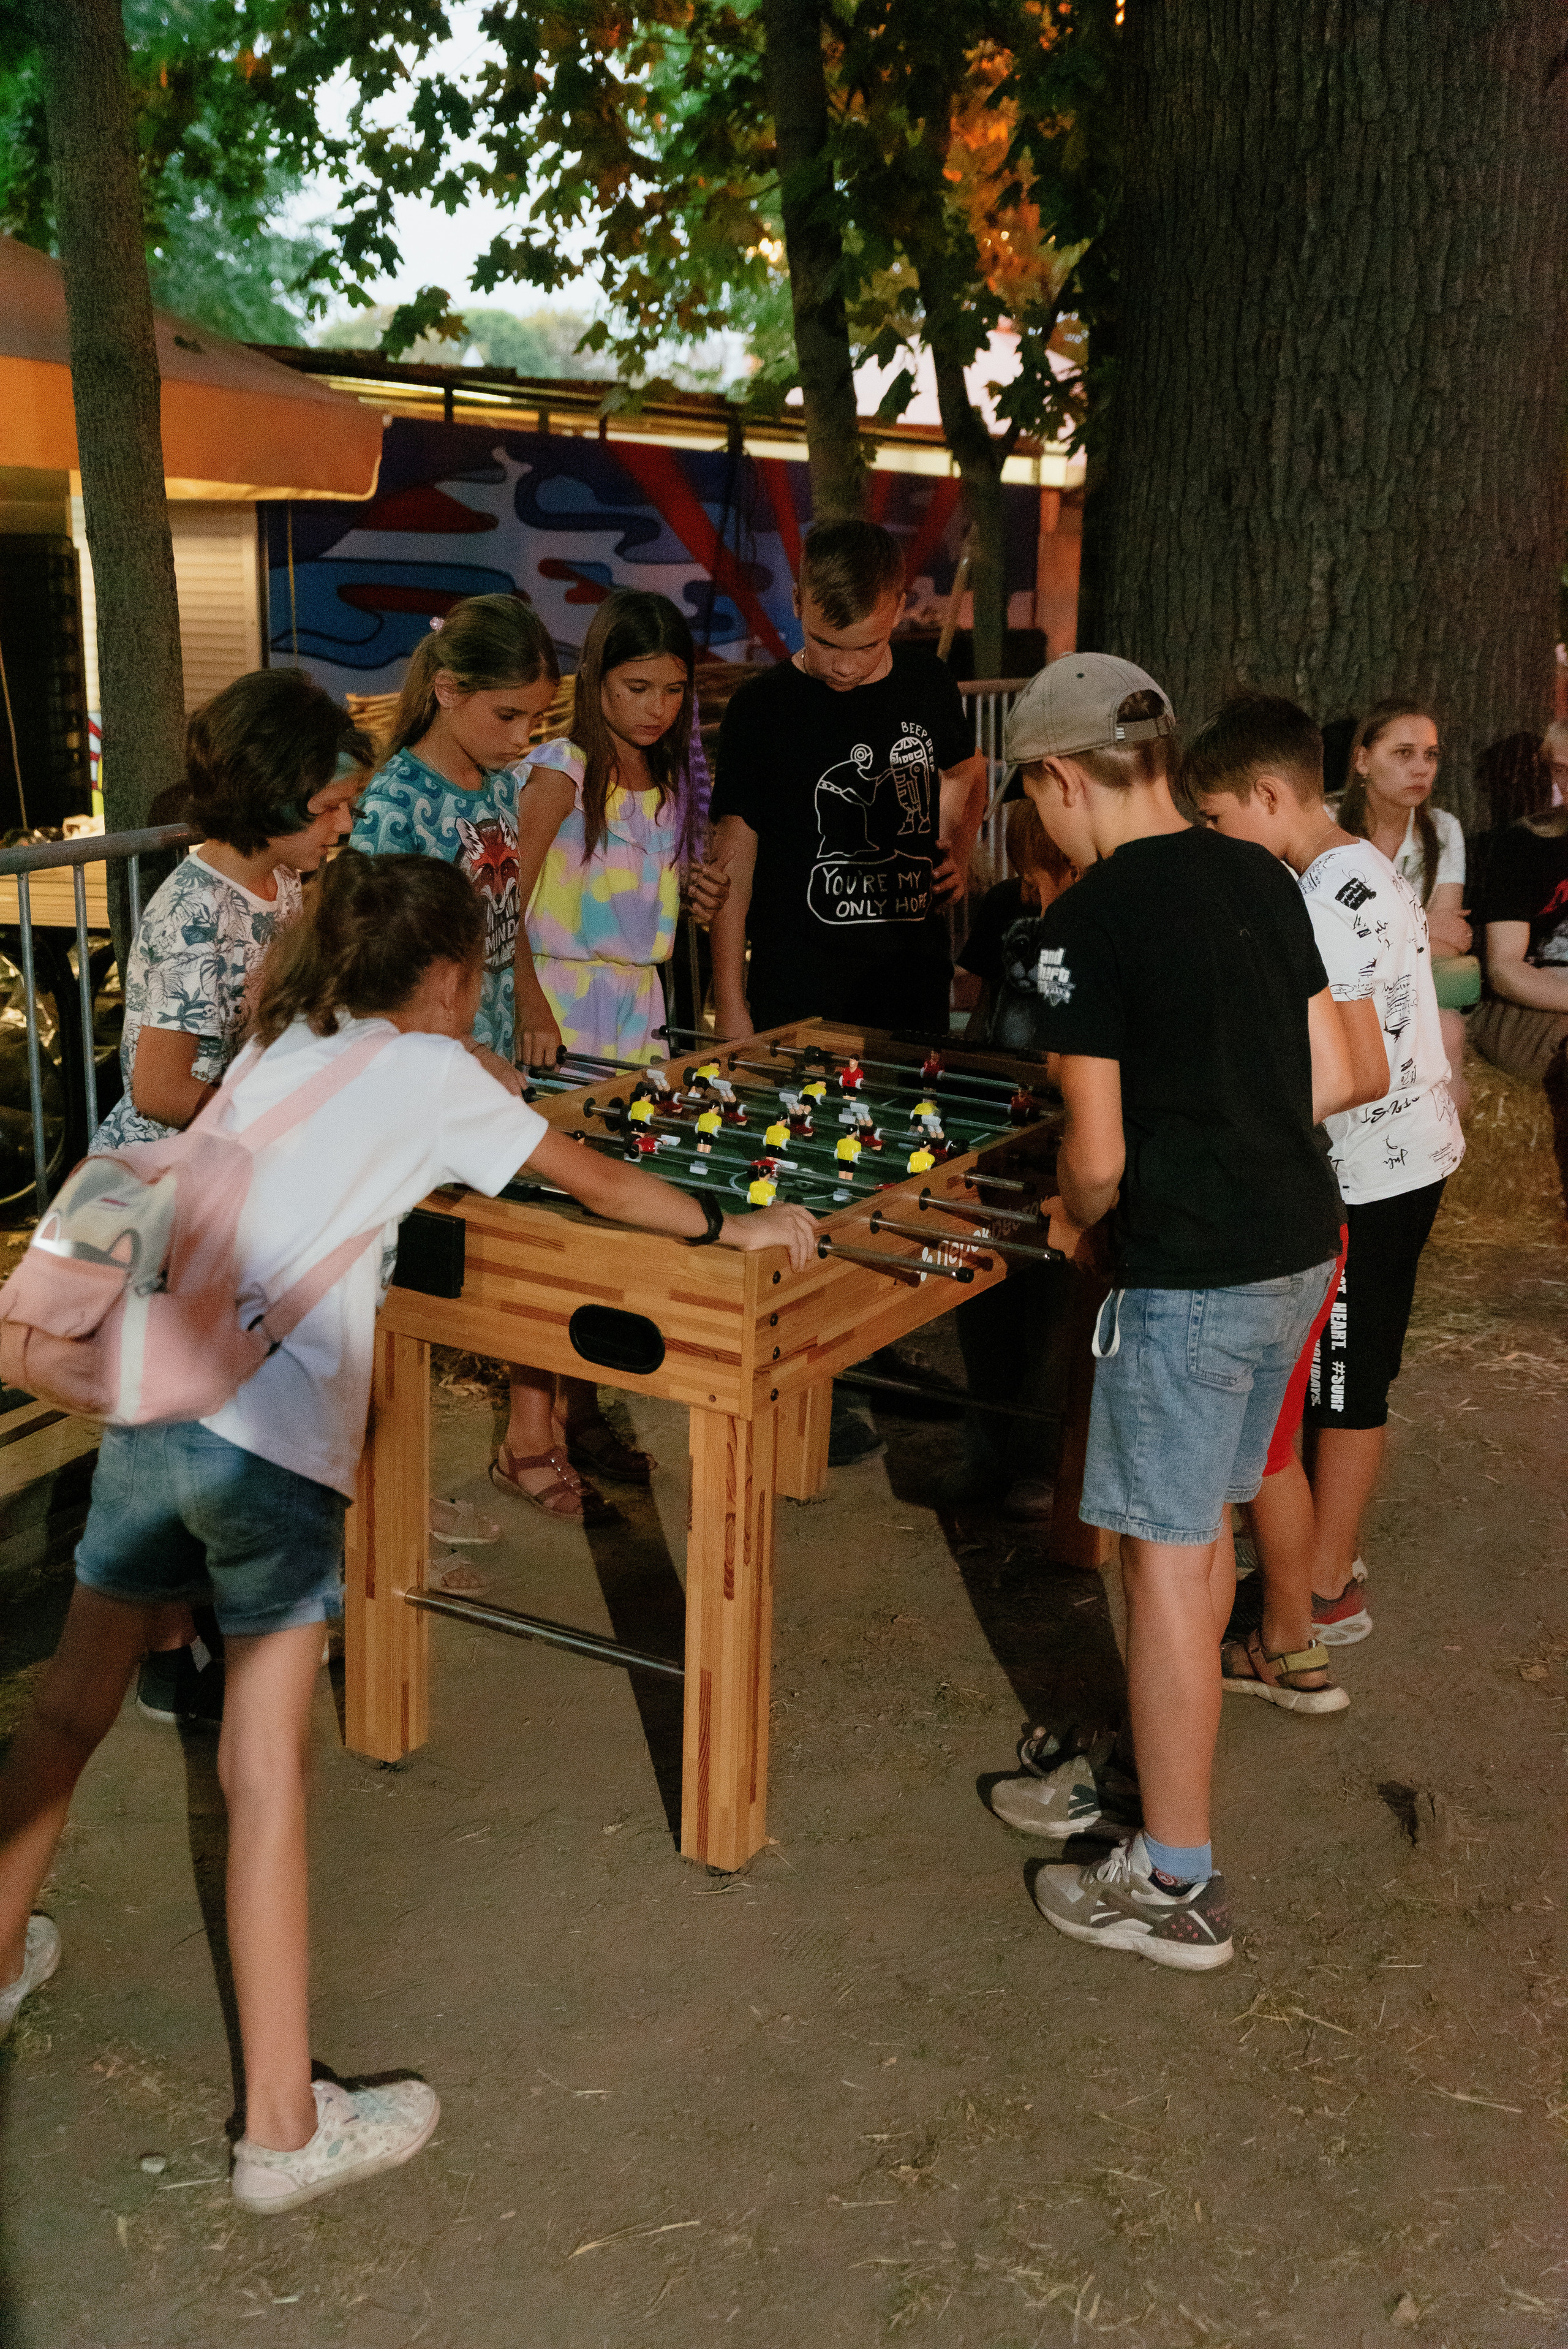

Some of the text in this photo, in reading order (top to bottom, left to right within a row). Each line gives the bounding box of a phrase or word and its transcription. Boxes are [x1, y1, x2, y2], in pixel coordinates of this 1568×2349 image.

[901, 721, 928, 738] BEEP
[822, 867, 921, 896] YOU'RE MY
[835, 899, 887, 918] ONLY
[1330, 1302, 1347, 1350] HEART.
[1330, 1361, 1346, 1412] #SURF
